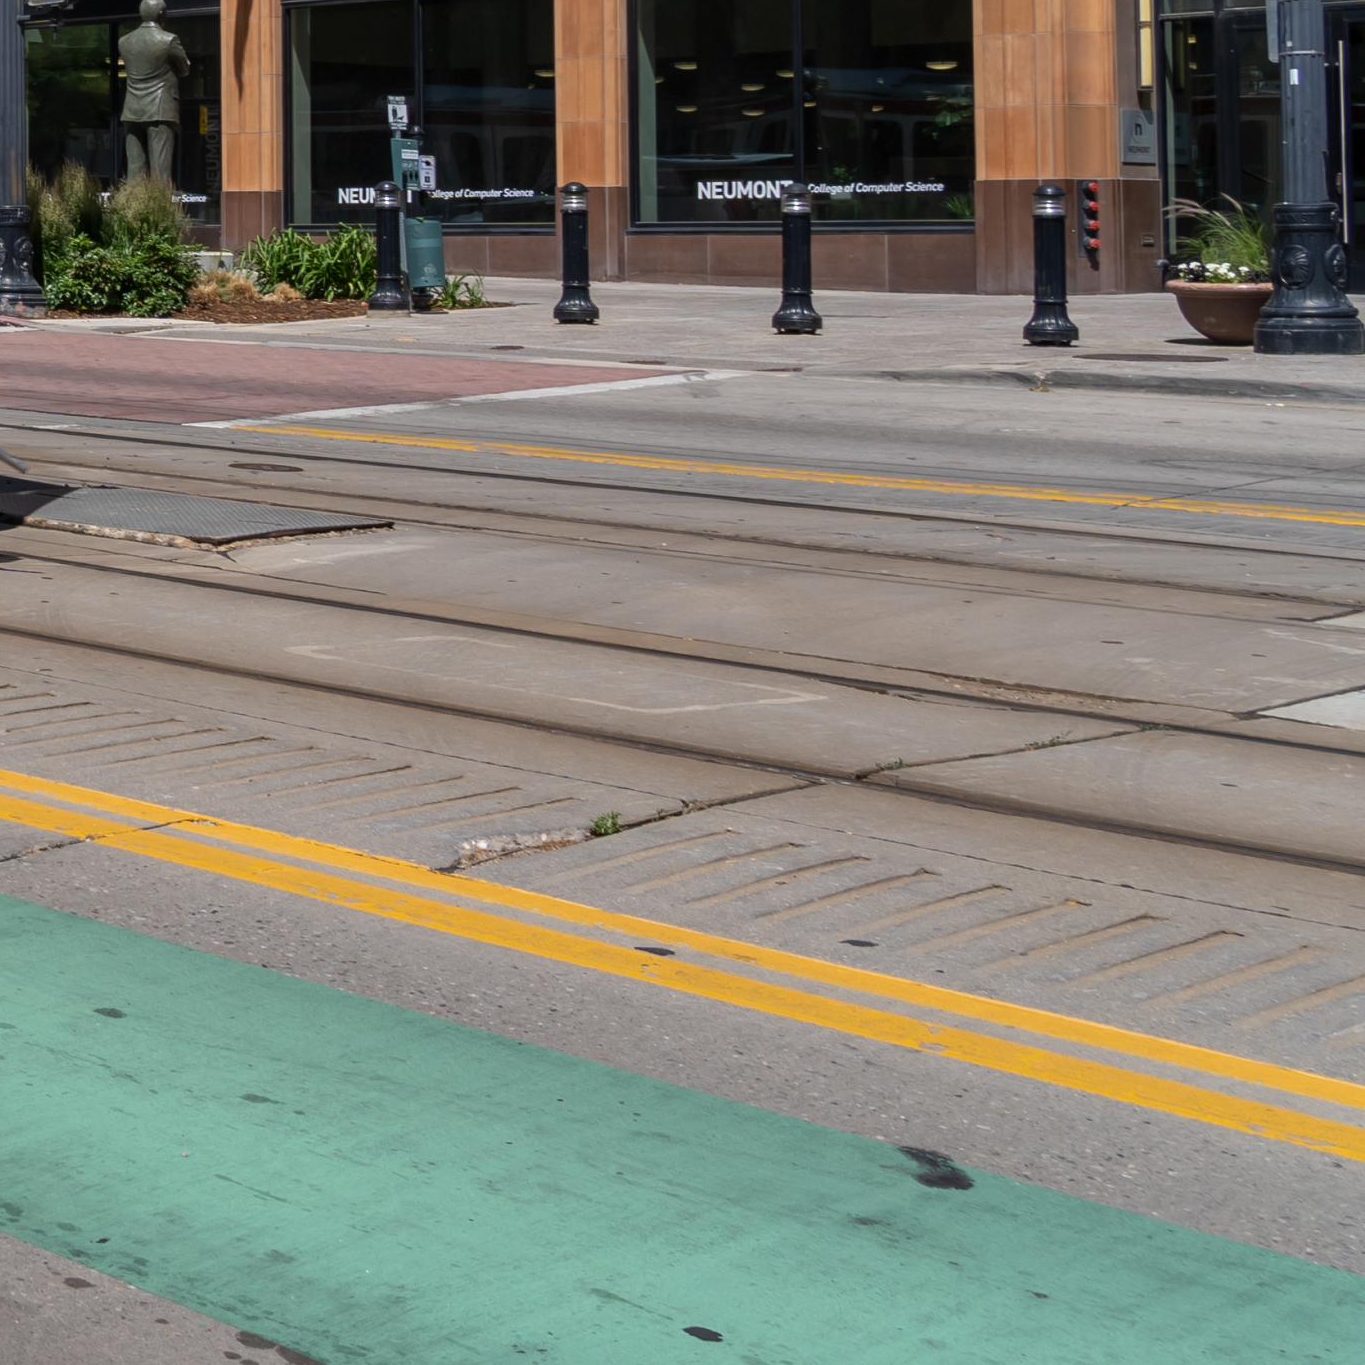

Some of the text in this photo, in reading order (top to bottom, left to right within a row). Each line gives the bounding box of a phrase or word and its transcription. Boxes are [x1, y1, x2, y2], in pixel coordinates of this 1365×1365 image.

[455, 189, 464, 198] of
[464, 189, 502, 199] Computer
[503, 188, 534, 198] Science
[808, 184, 843, 195] College
[844, 183, 855, 193] of
[856, 182, 904, 194] Computer
[906, 181, 944, 192] Science
[181, 194, 207, 203] Science
